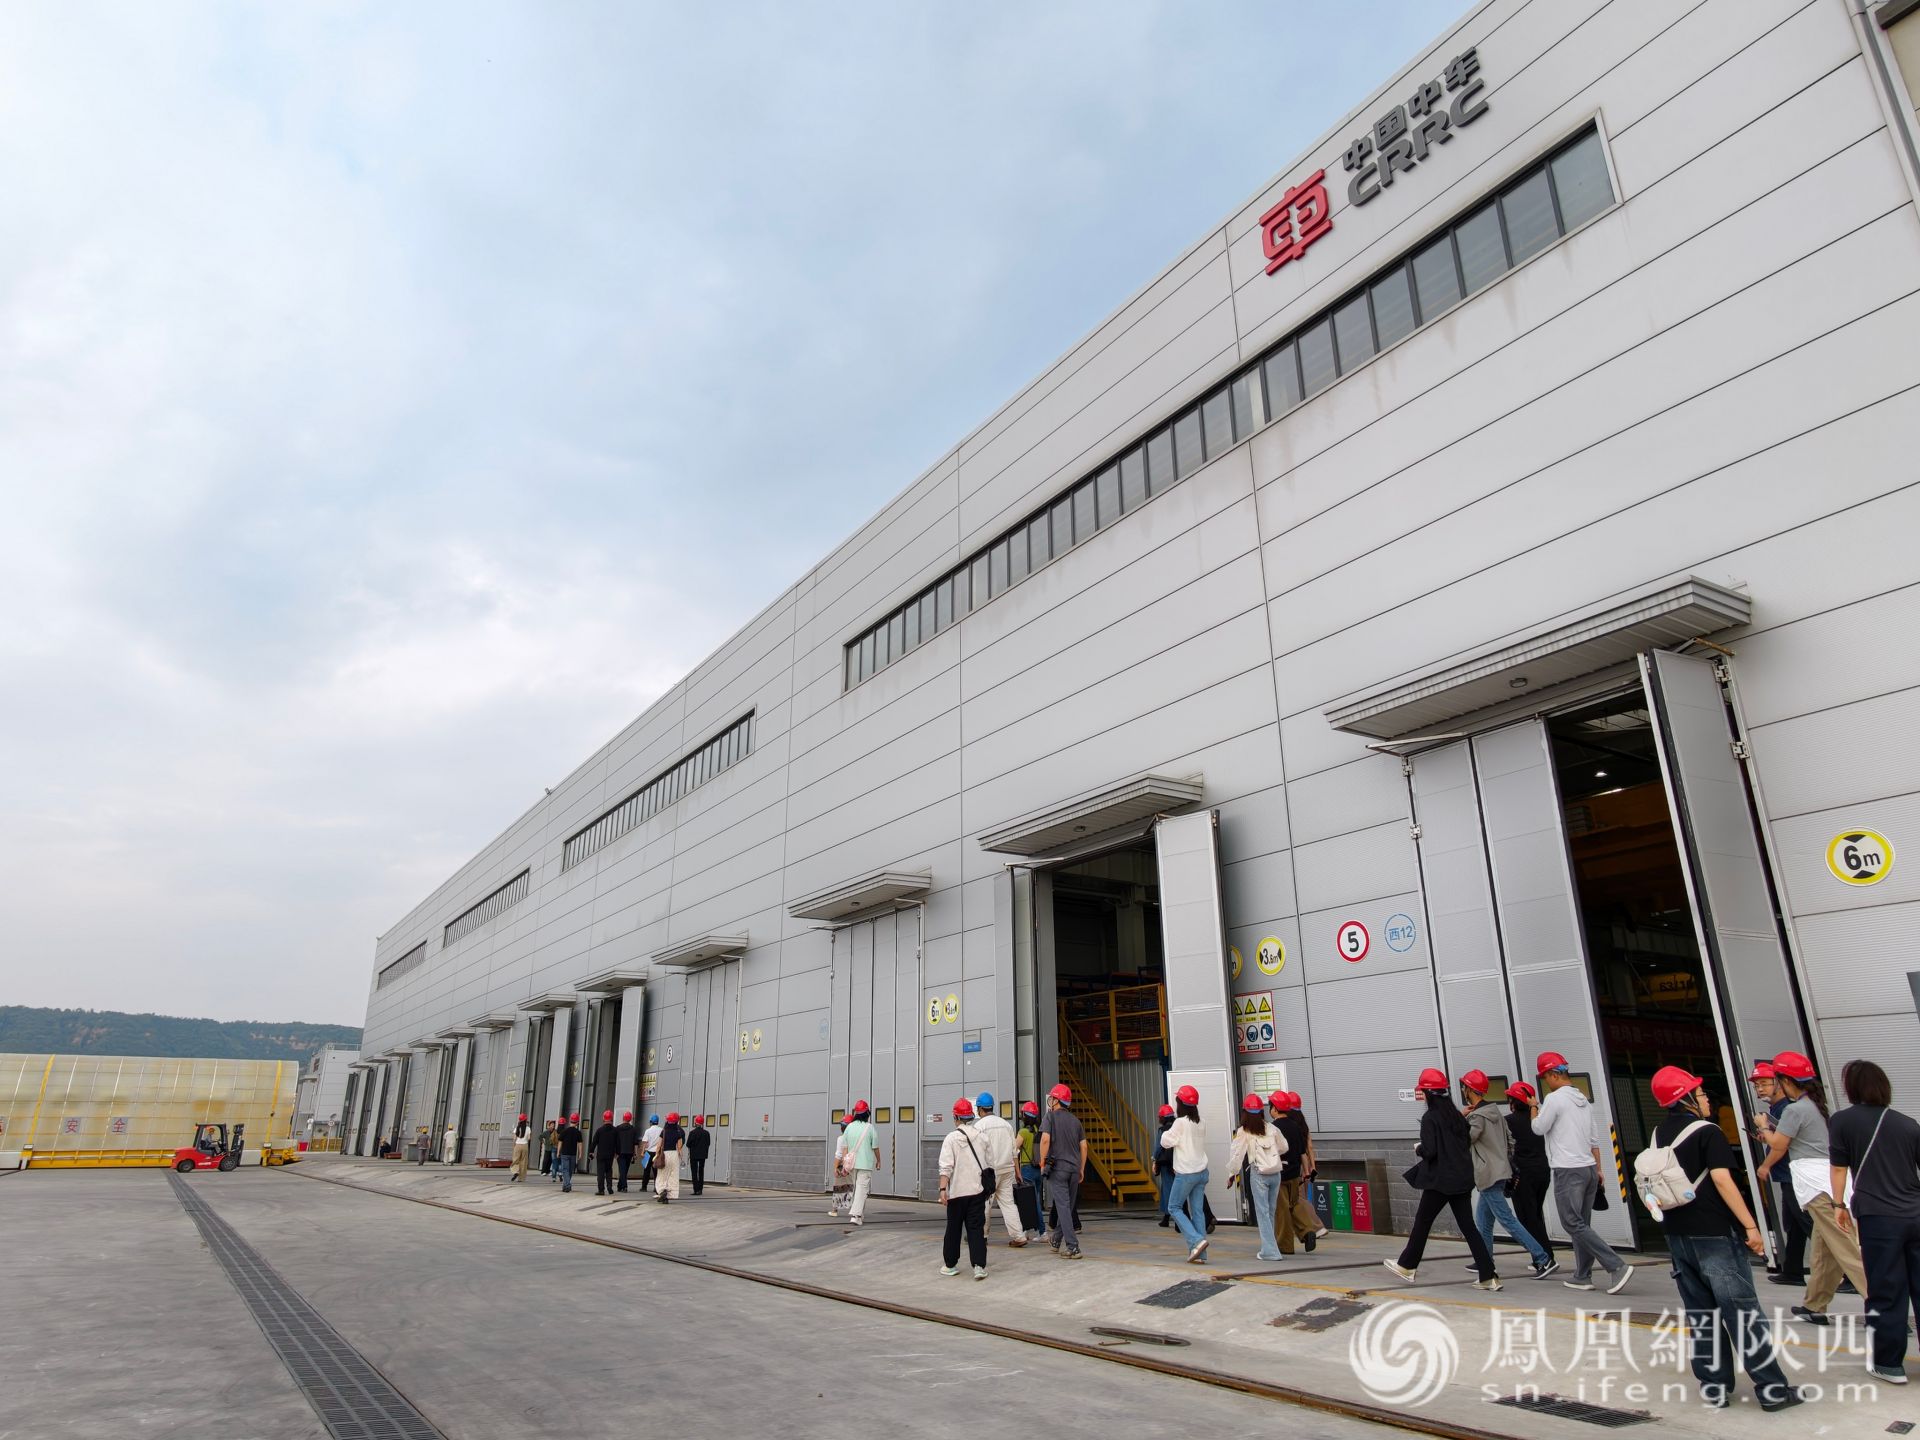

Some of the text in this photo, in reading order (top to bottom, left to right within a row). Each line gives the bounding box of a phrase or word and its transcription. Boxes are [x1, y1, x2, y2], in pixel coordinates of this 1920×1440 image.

[1343, 46, 1481, 171] 中国中车
[1348, 78, 1489, 207] CRRC
[1843, 844, 1881, 871] 6m
[1347, 931, 1359, 953] 5
[1388, 925, 1413, 941] 西12
